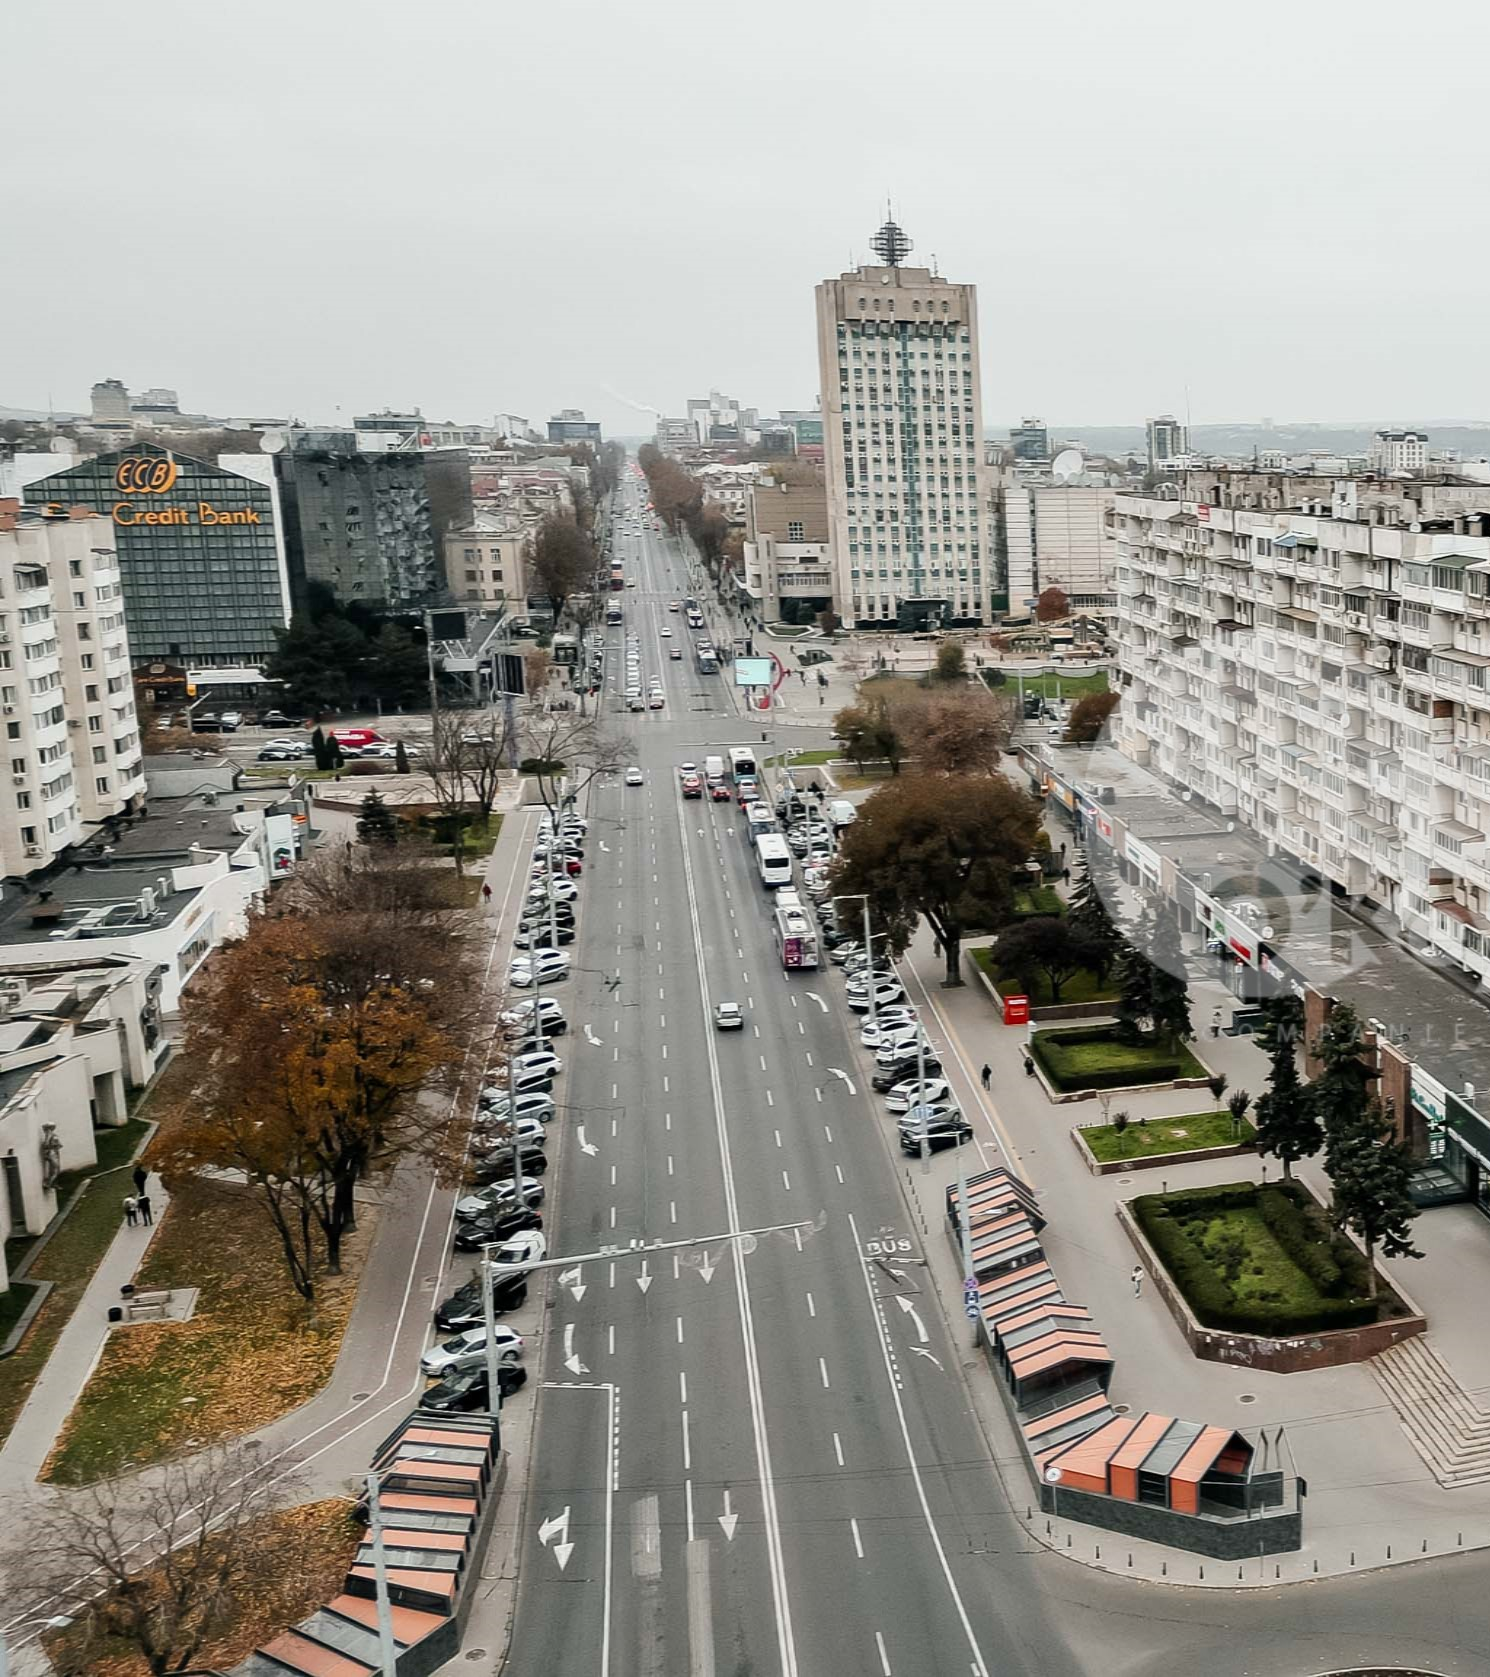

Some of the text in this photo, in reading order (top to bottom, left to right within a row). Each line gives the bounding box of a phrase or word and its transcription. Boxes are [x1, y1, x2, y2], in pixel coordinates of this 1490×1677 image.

[112, 502, 261, 526] Credit Bank
[866, 1238, 911, 1256] BUS
